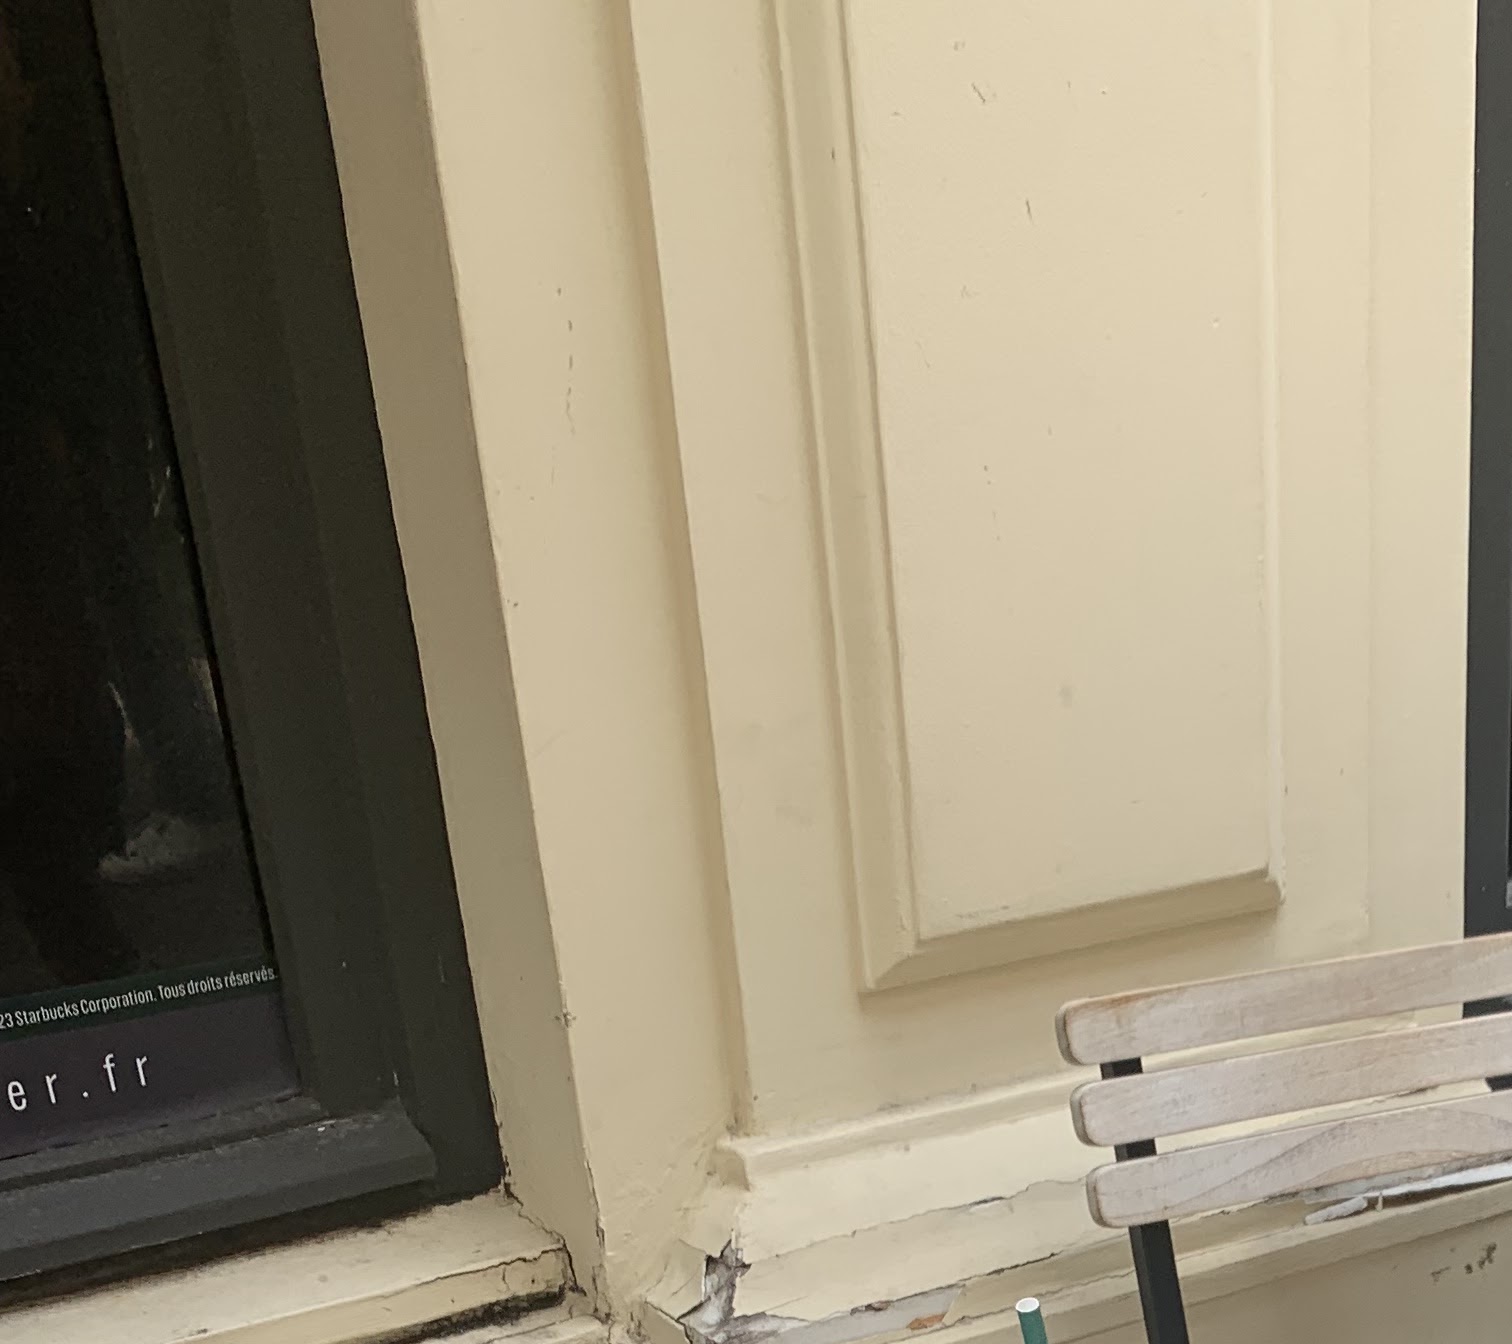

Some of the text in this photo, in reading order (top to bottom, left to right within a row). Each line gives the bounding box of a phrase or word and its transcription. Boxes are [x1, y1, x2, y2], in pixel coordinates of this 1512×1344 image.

[16, 1002, 79, 1026] Starbucks
[80, 988, 157, 1015] Corporation.
[157, 983, 187, 1000] Tous
[187, 976, 223, 996] droits
[224, 965, 278, 989] réservés.
